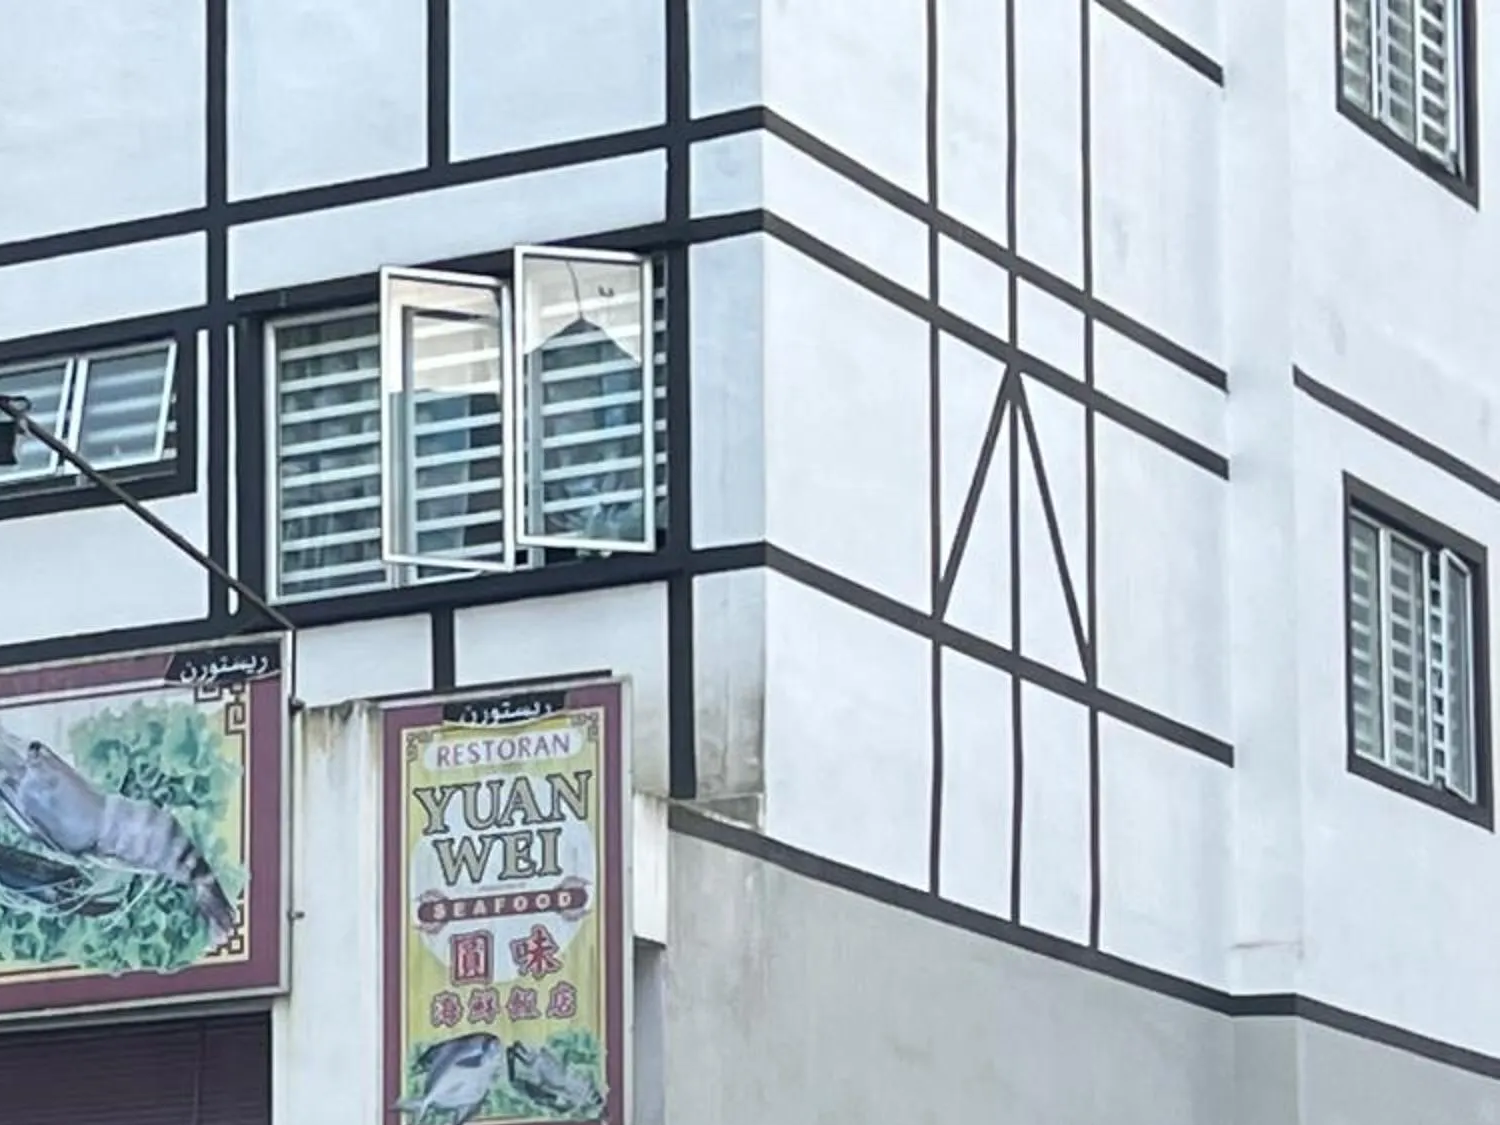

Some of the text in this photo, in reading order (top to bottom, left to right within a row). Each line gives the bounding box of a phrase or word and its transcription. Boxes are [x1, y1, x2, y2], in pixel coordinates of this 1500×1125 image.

[436, 733, 571, 769] RESTORAN
[412, 769, 593, 836] YUAN
[431, 826, 563, 887] WEI
[432, 891, 572, 920] SEAFOOD
